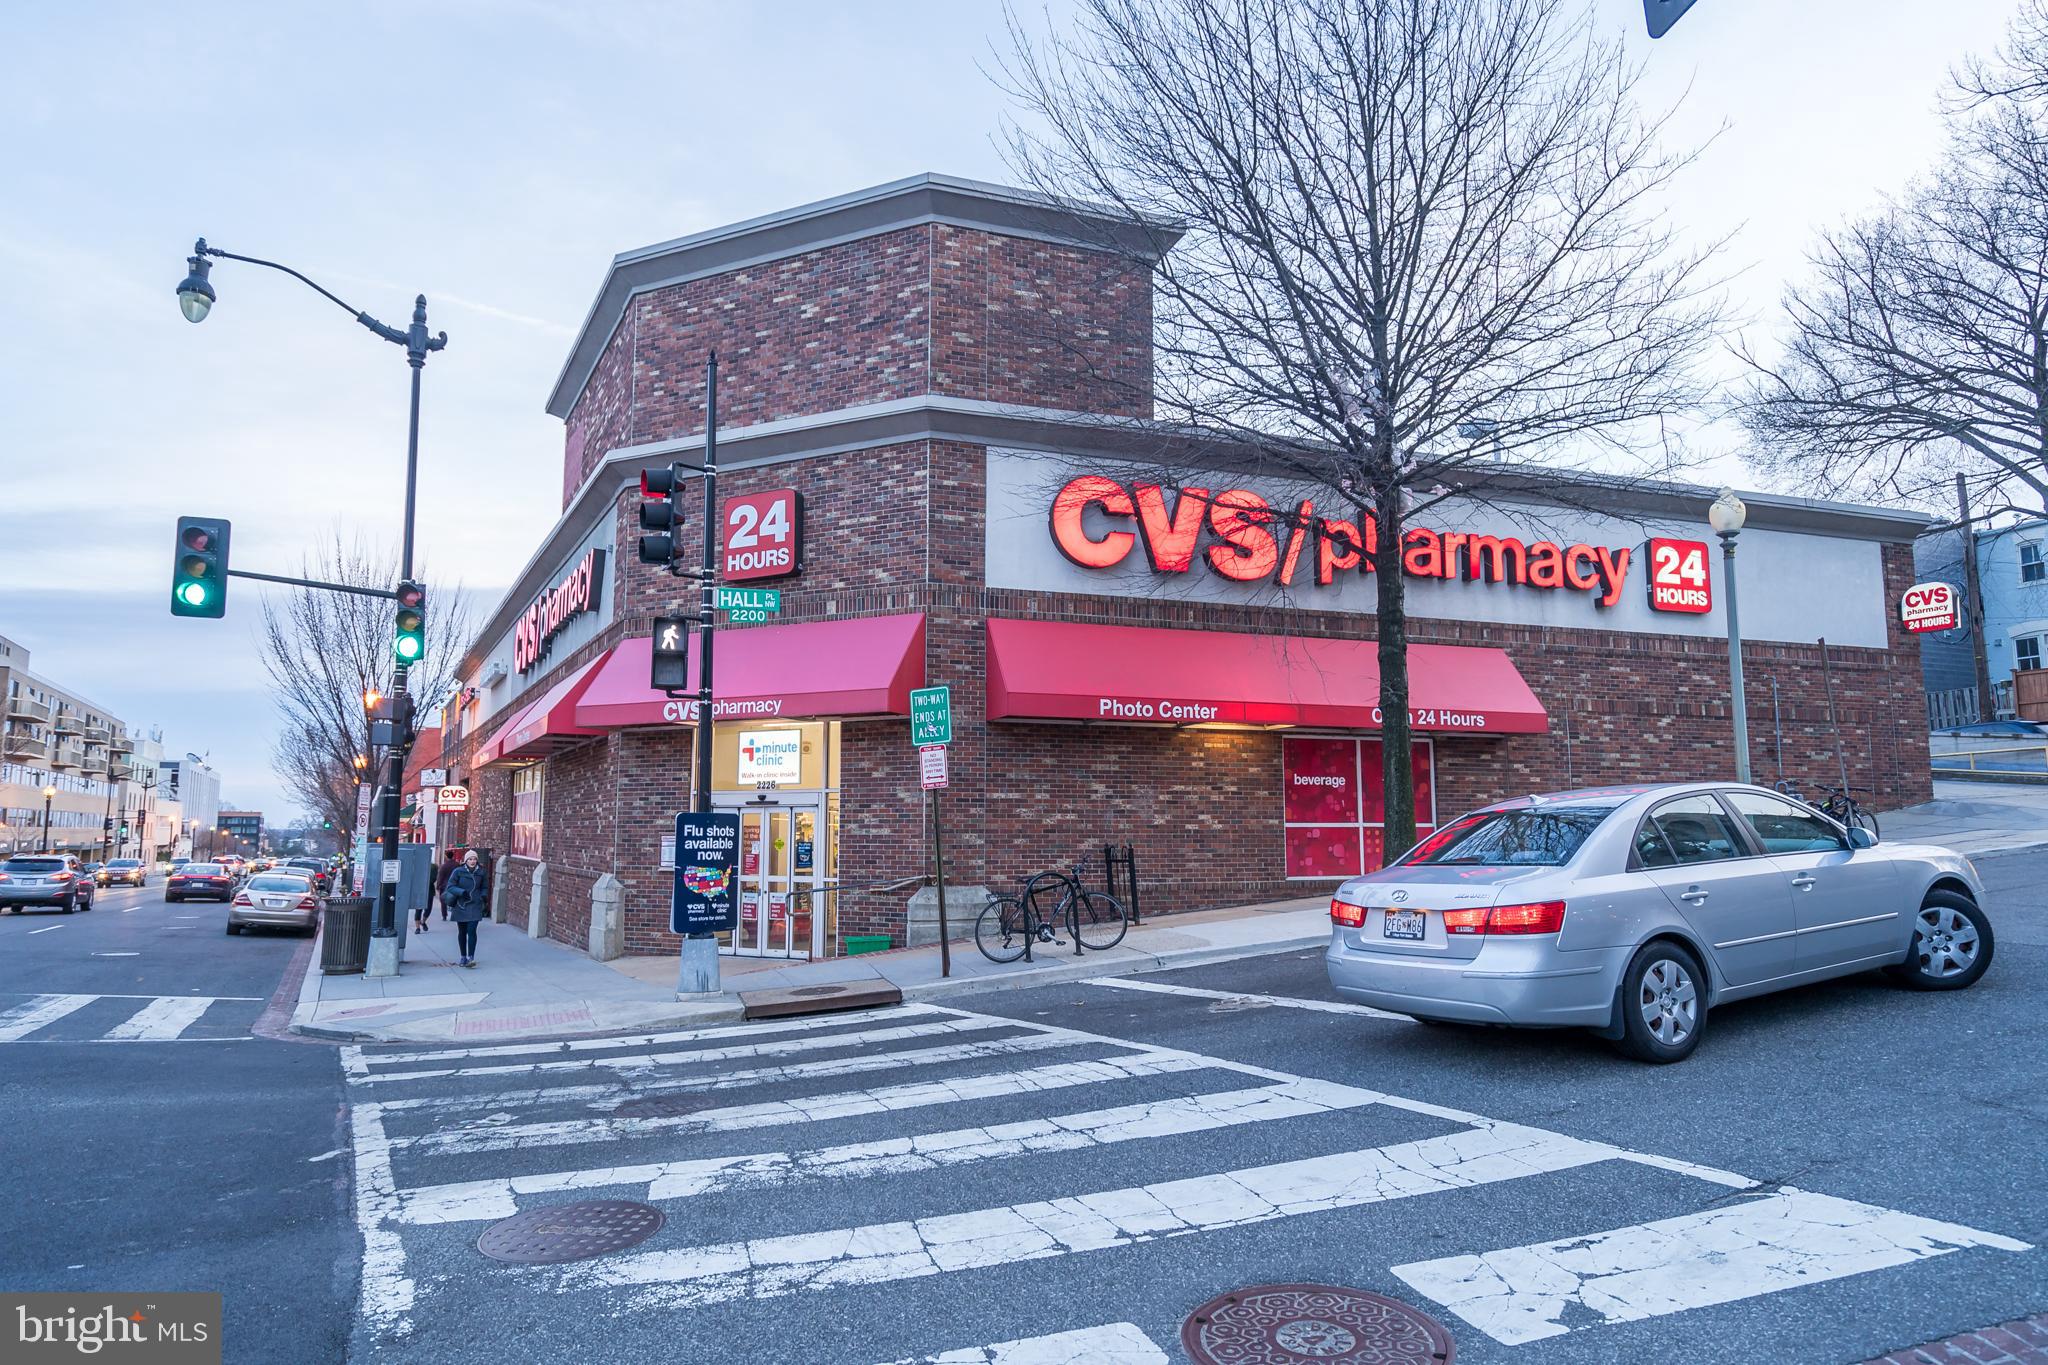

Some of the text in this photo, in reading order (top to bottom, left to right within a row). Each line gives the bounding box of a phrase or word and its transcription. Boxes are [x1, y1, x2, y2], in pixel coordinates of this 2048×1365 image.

[728, 499, 790, 549] 24
[727, 547, 790, 572] HOURS
[1655, 545, 1707, 587] 24
[720, 591, 776, 608] HALL PL
[764, 600, 776, 608] NW
[1656, 588, 1708, 607] HOURS
[1905, 587, 1949, 608] CVS
[731, 610, 766, 622] 2200
[1906, 604, 1949, 617] pharmacy
[1908, 615, 1951, 630] 24 HOURS
[913, 693, 945, 707] TWO-WAY
[663, 699, 782, 721] CVS pharmacy
[1100, 698, 1218, 719] Photo Center
[914, 709, 947, 724] ENDS AT
[1417, 709, 1436, 725] 24
[1440, 710, 1485, 727] Hours
[762, 741, 798, 753] minute
[756, 754, 783, 766] clinic
[756, 780, 776, 790] 2226
[1294, 773, 1346, 788] beverage
[441, 789, 466, 798] CVS
[684, 824, 735, 837] Flu shots
[684, 838, 734, 850] available
[697, 851, 724, 861] now.
